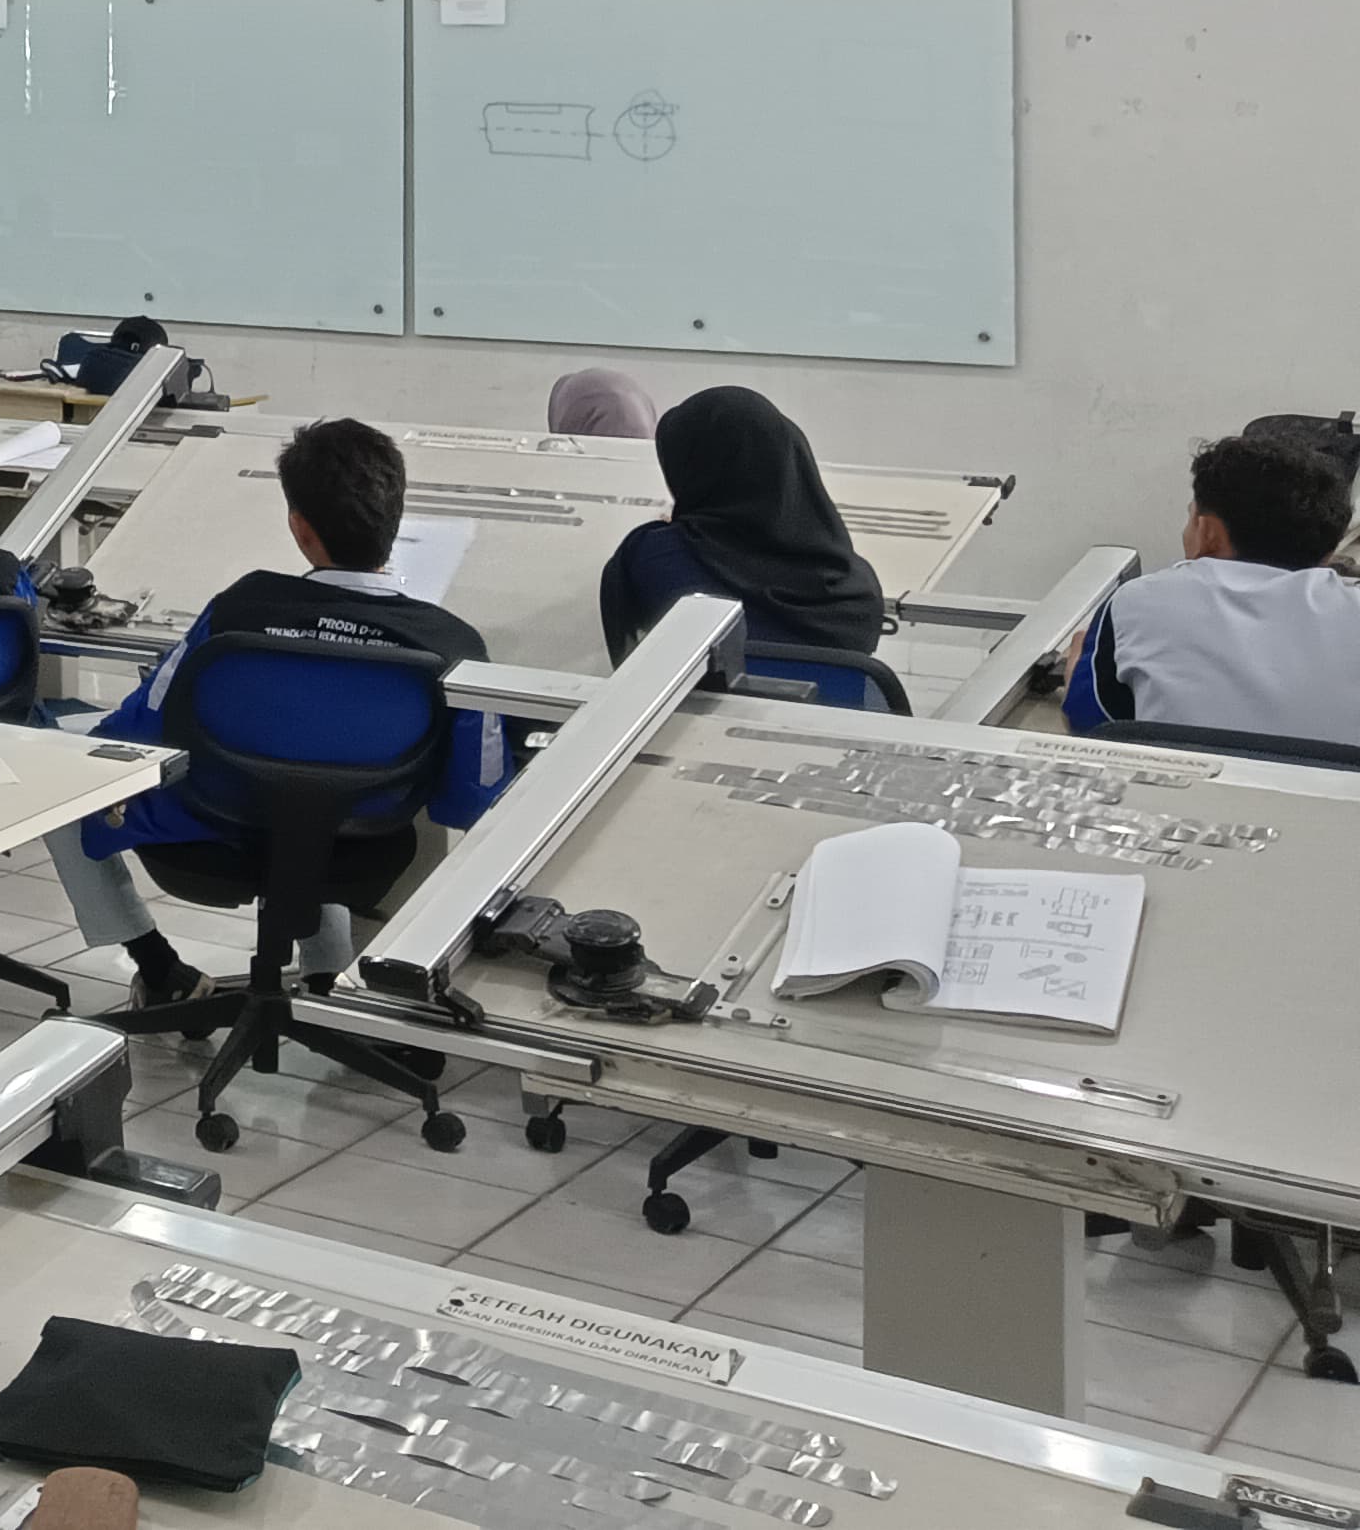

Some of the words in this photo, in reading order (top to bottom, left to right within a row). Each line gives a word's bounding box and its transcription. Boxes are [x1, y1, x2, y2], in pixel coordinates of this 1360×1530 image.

[466, 1292, 566, 1324] SETELAH
[569, 1318, 720, 1362] DIGUNAKAN
[494, 1317, 586, 1346] DIBERSIHKAN
[588, 1340, 622, 1355] DAN
[624, 1349, 705, 1375] DIRAPIKAN
